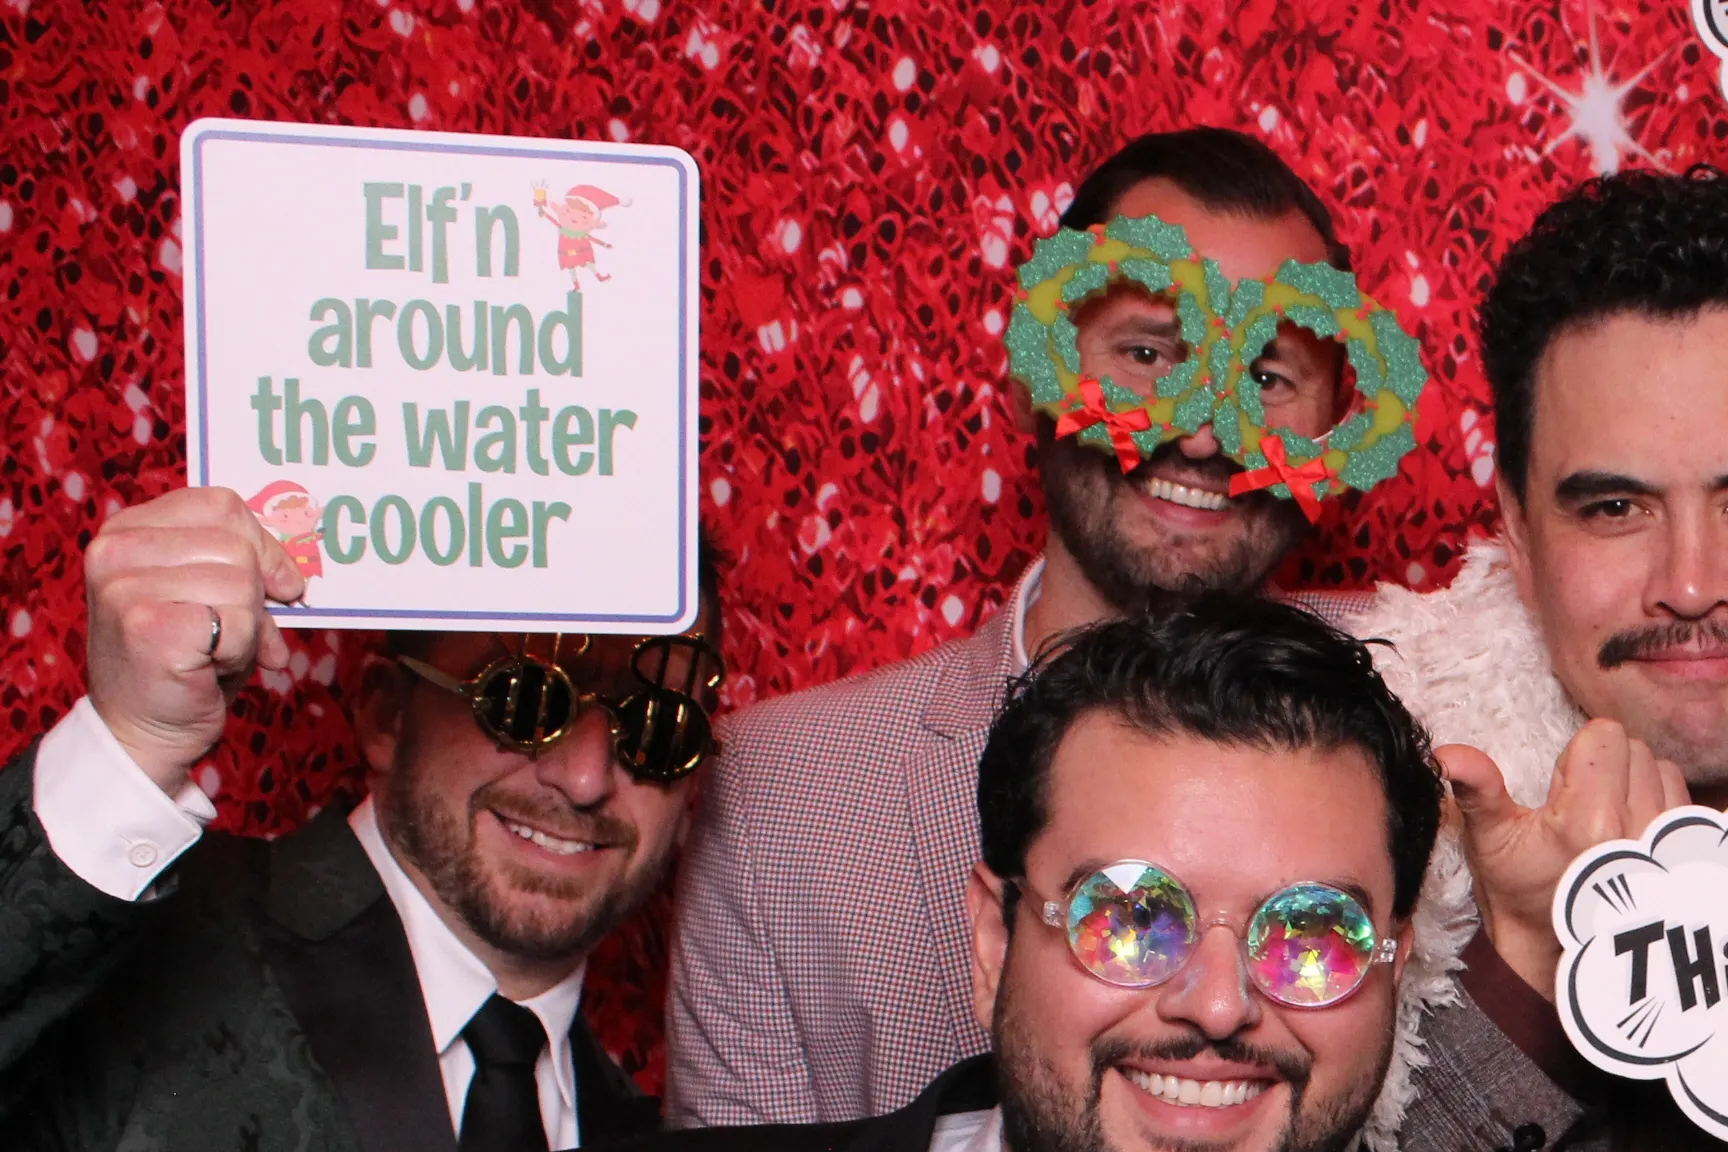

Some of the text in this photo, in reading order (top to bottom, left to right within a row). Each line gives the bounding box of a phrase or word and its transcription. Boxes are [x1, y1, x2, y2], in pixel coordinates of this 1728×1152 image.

[363, 182, 518, 283] Elf'n
[307, 291, 581, 377] around
[249, 375, 636, 476] the water
[317, 480, 570, 568] cooler
